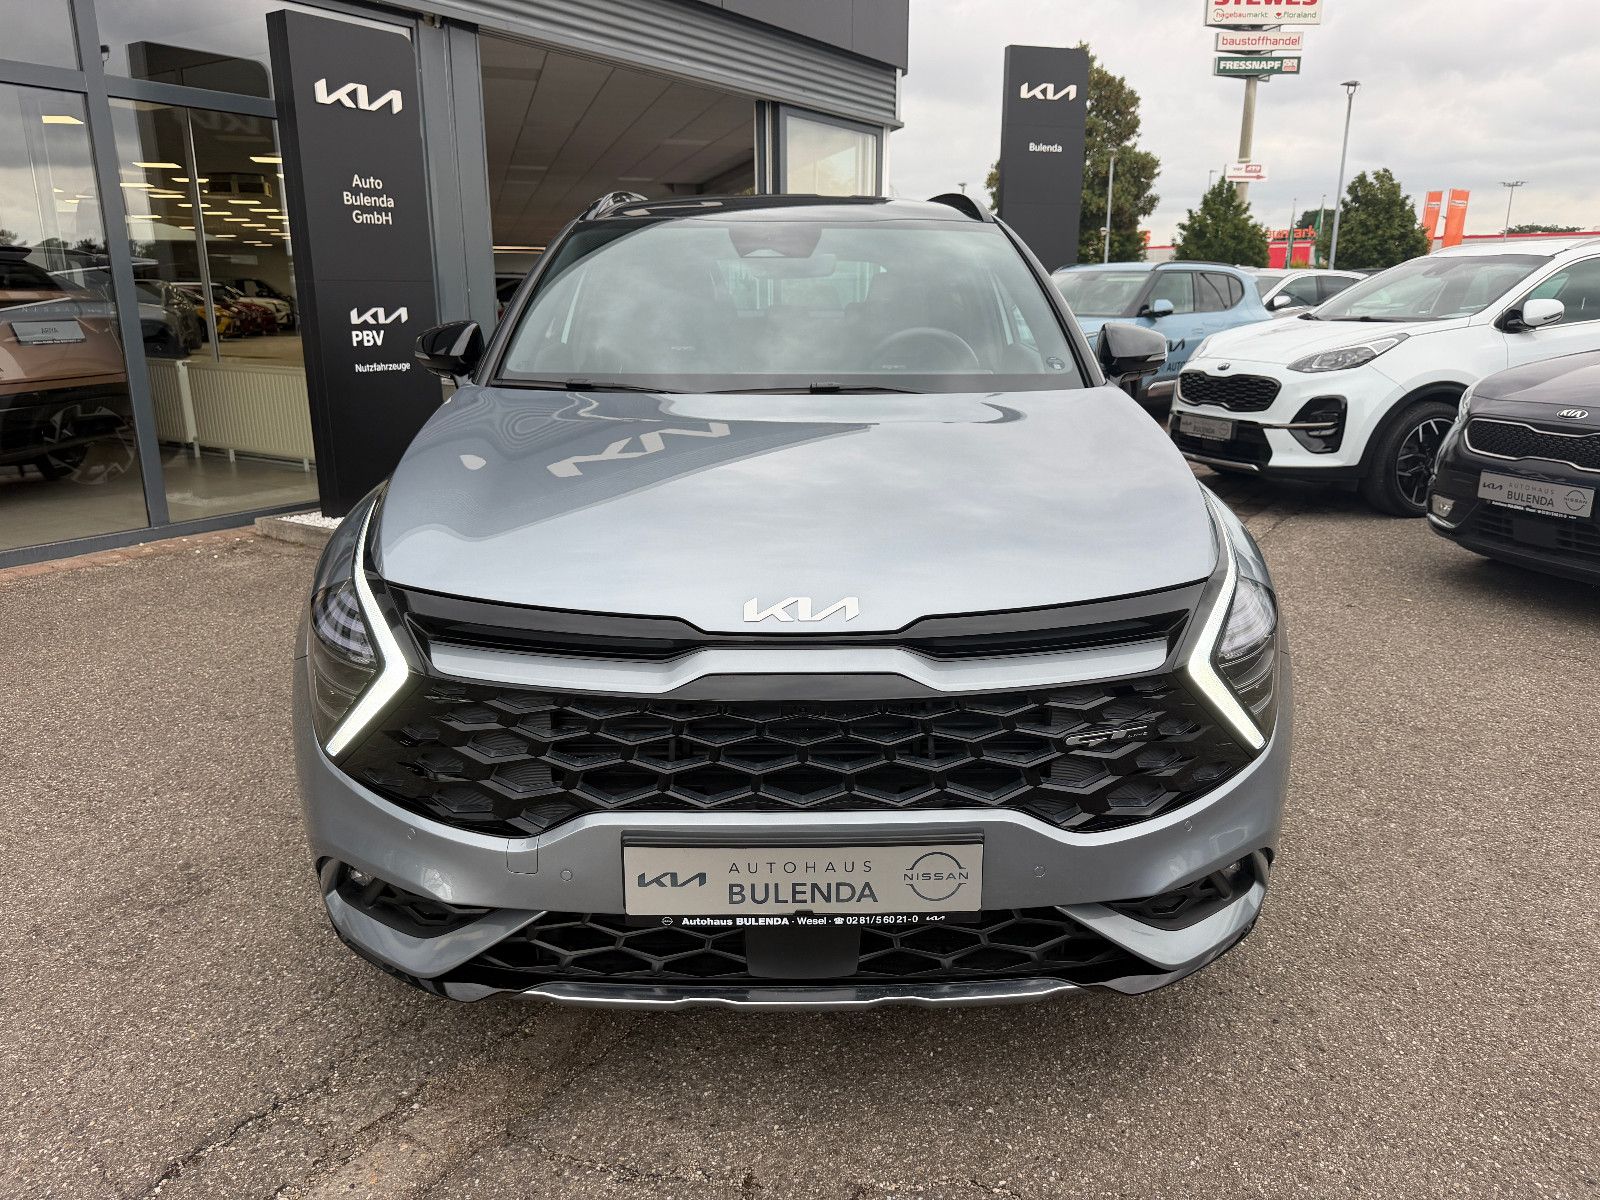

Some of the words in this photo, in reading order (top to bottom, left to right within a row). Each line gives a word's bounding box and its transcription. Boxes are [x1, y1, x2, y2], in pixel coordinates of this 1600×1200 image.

[1221, 36, 1301, 46] baustoffhandel
[1219, 60, 1282, 70] FRESSNAPF
[314, 78, 403, 114] KIA
[1020, 82, 1077, 101] KIA
[1028, 142, 1063, 153] Bulenda
[352, 174, 383, 189] Auto
[343, 191, 395, 208] Bulenda
[352, 210, 393, 225] GmbH
[350, 306, 409, 325] KIA
[351, 330, 385, 347] PBV
[354, 362, 411, 373] Nutzfahrzeuge
[1508, 482, 1555, 495] AUTOHAUS
[1506, 490, 1555, 507] BULENDA
[743, 597, 859, 622] KIA
[728, 861, 872, 874] AUTOHAUS
[637, 871, 707, 888] KIA
[903, 872, 969, 881] NISSAN
[728, 881, 879, 905] BULENDA
[681, 917, 733, 926] Autohaus
[735, 917, 789, 926] BULENDA
[796, 916, 827, 925] Wesel
